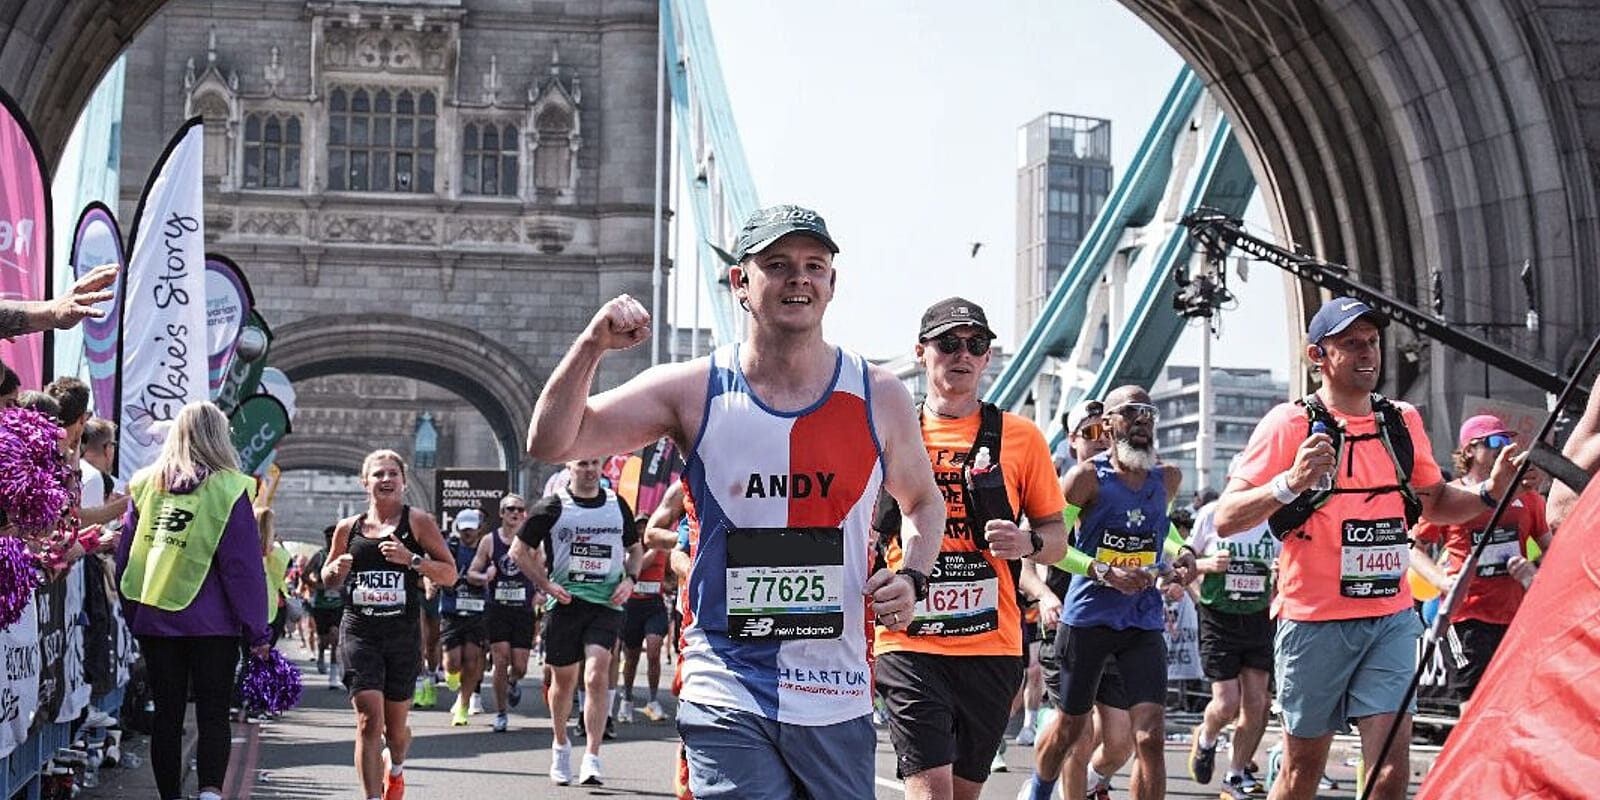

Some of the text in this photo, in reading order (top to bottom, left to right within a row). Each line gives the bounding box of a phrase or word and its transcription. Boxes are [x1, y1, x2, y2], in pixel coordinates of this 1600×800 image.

[147, 211, 199, 422] Elsie's Story
[206, 305, 237, 318] varian
[207, 315, 235, 327] ancer
[443, 479, 470, 488] TATA
[745, 472, 836, 499] ANDY
[443, 489, 504, 498] CONSULTANCY
[443, 498, 482, 507] SERVICES
[575, 526, 622, 536] Independ
[1345, 523, 1374, 542] tcs
[944, 555, 965, 563] TATA
[1356, 551, 1402, 572] 14404
[358, 572, 401, 588] PAISLEY
[746, 575, 825, 604] 77625
[774, 628, 795, 636] new
[796, 621, 834, 636] balance
[778, 668, 867, 685] HEART UK
